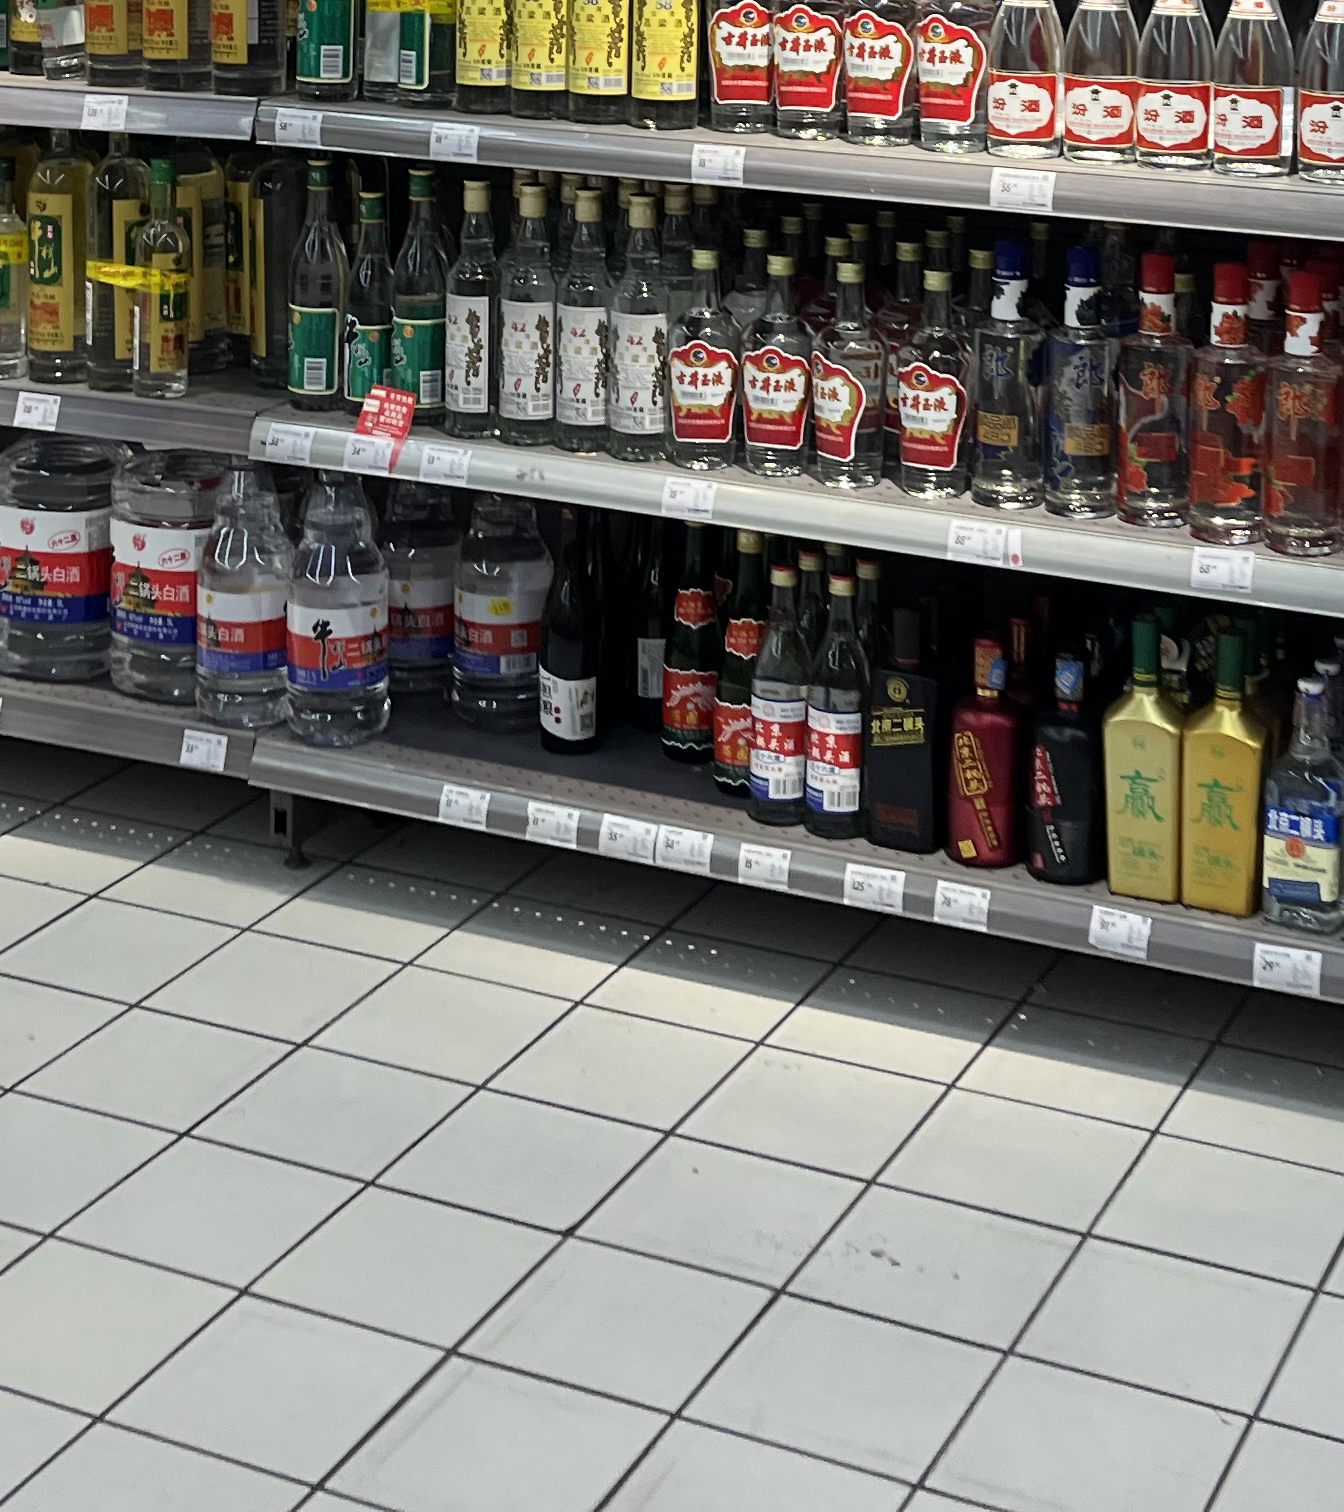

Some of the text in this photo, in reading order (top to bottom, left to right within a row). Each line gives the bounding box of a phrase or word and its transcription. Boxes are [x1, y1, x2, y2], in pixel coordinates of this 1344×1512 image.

[511, 320, 527, 334] 42
[570, 325, 587, 338] 42
[627, 333, 644, 347] 42
[1267, 807, 1327, 840] 北京二锅头
